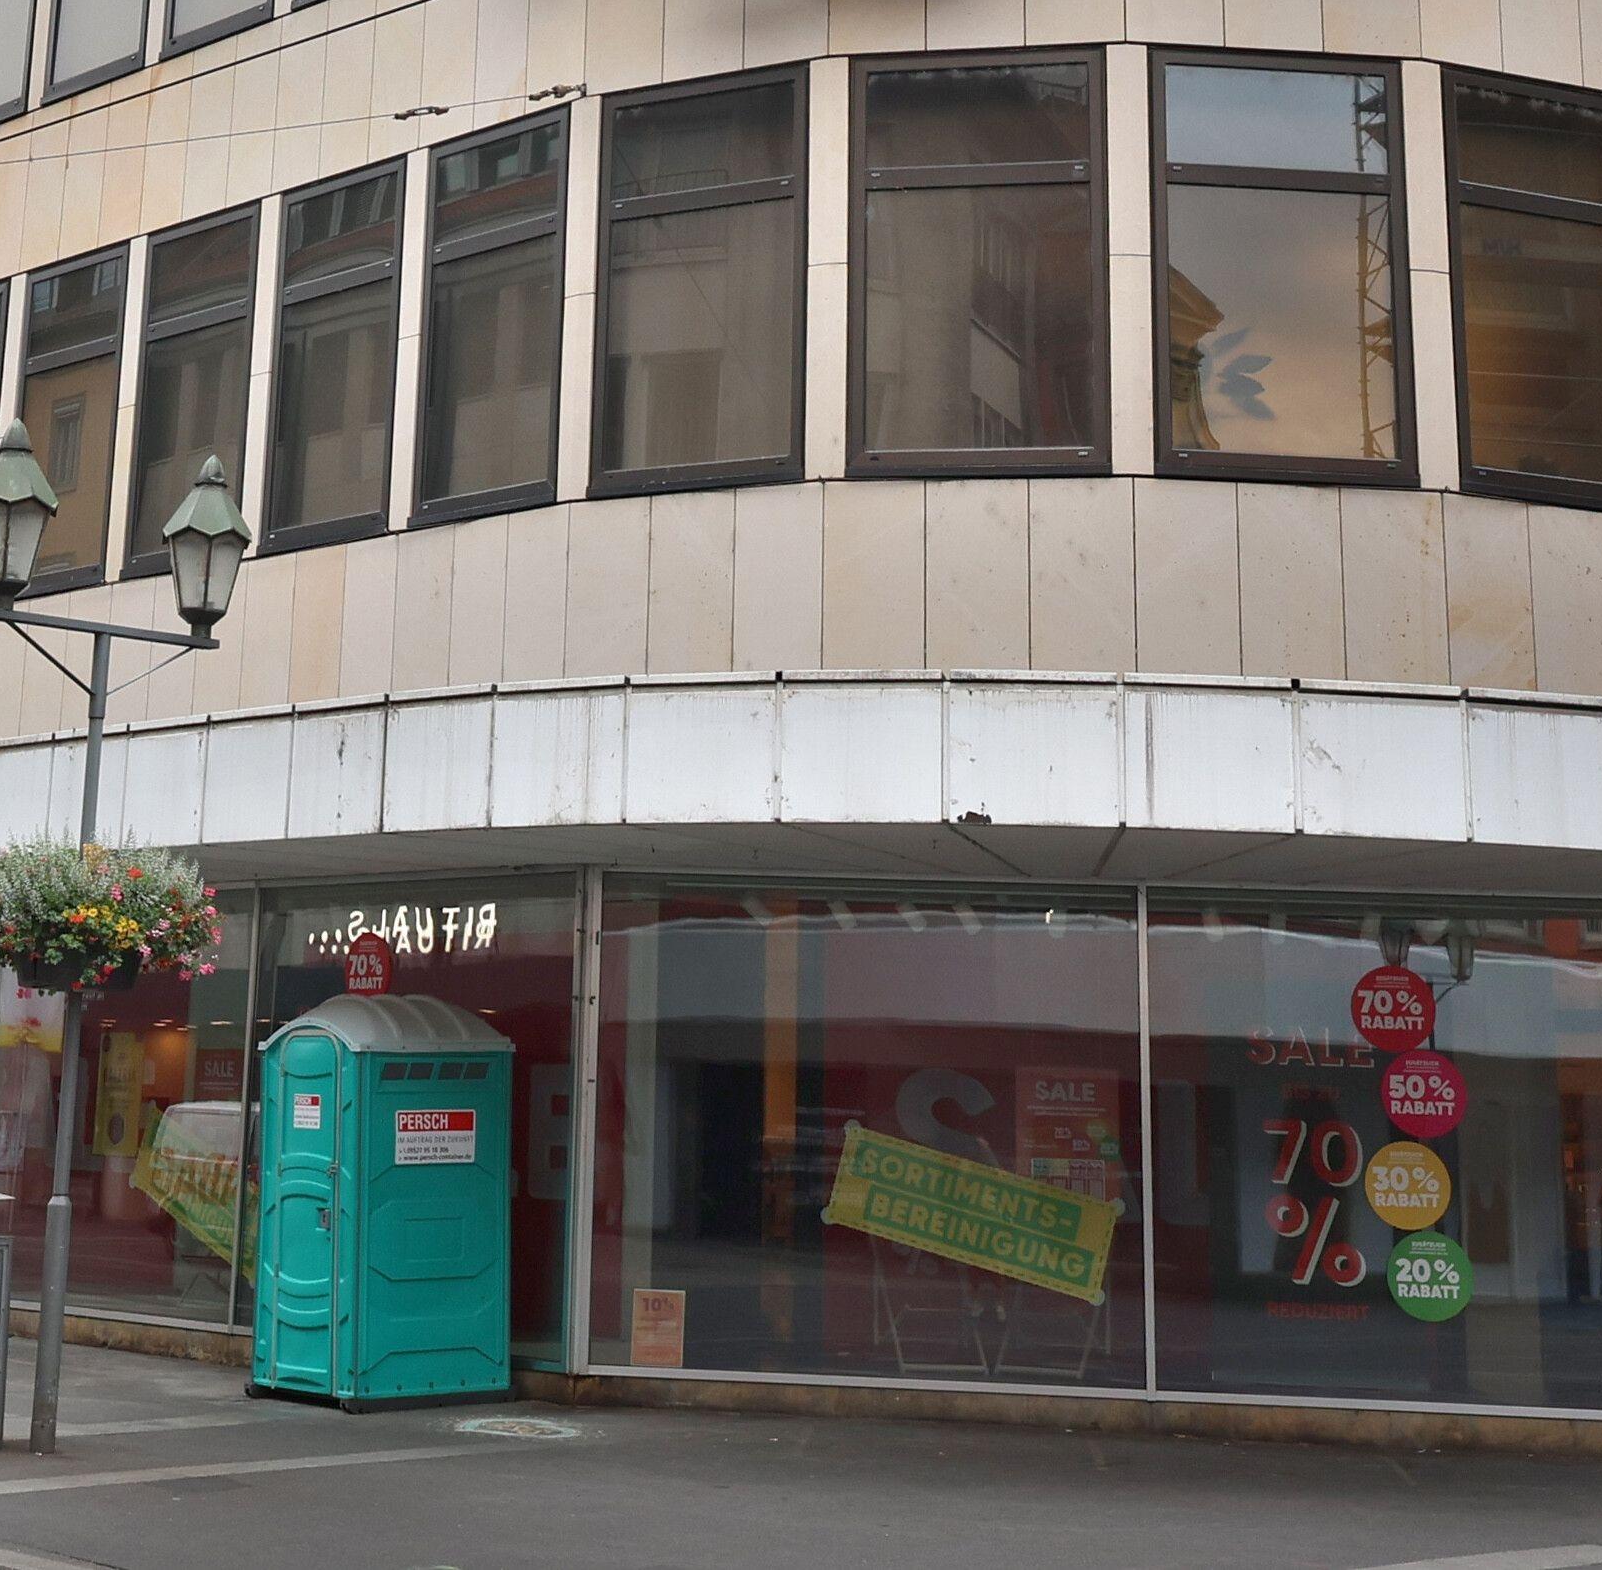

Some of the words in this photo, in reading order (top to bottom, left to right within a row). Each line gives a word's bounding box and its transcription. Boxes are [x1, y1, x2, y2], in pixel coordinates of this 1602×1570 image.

[349, 977, 383, 990] RABATT
[1360, 1015, 1425, 1031] RABATT
[1245, 1026, 1376, 1069] SALE
[204, 1060, 235, 1079] SALE
[1035, 1080, 1096, 1103] SALE
[1390, 1100, 1456, 1116] RABATT
[398, 1113, 449, 1131] PERSCH
[1261, 1118, 1364, 1188] 70
[859, 1148, 1075, 1230] SORTIMENTS-
[1374, 1192, 1440, 1208] RABATT
[870, 1192, 1087, 1278] BEREINIGUNG
[1265, 1192, 1368, 1289] %
[1396, 1282, 1461, 1299] RABATT
